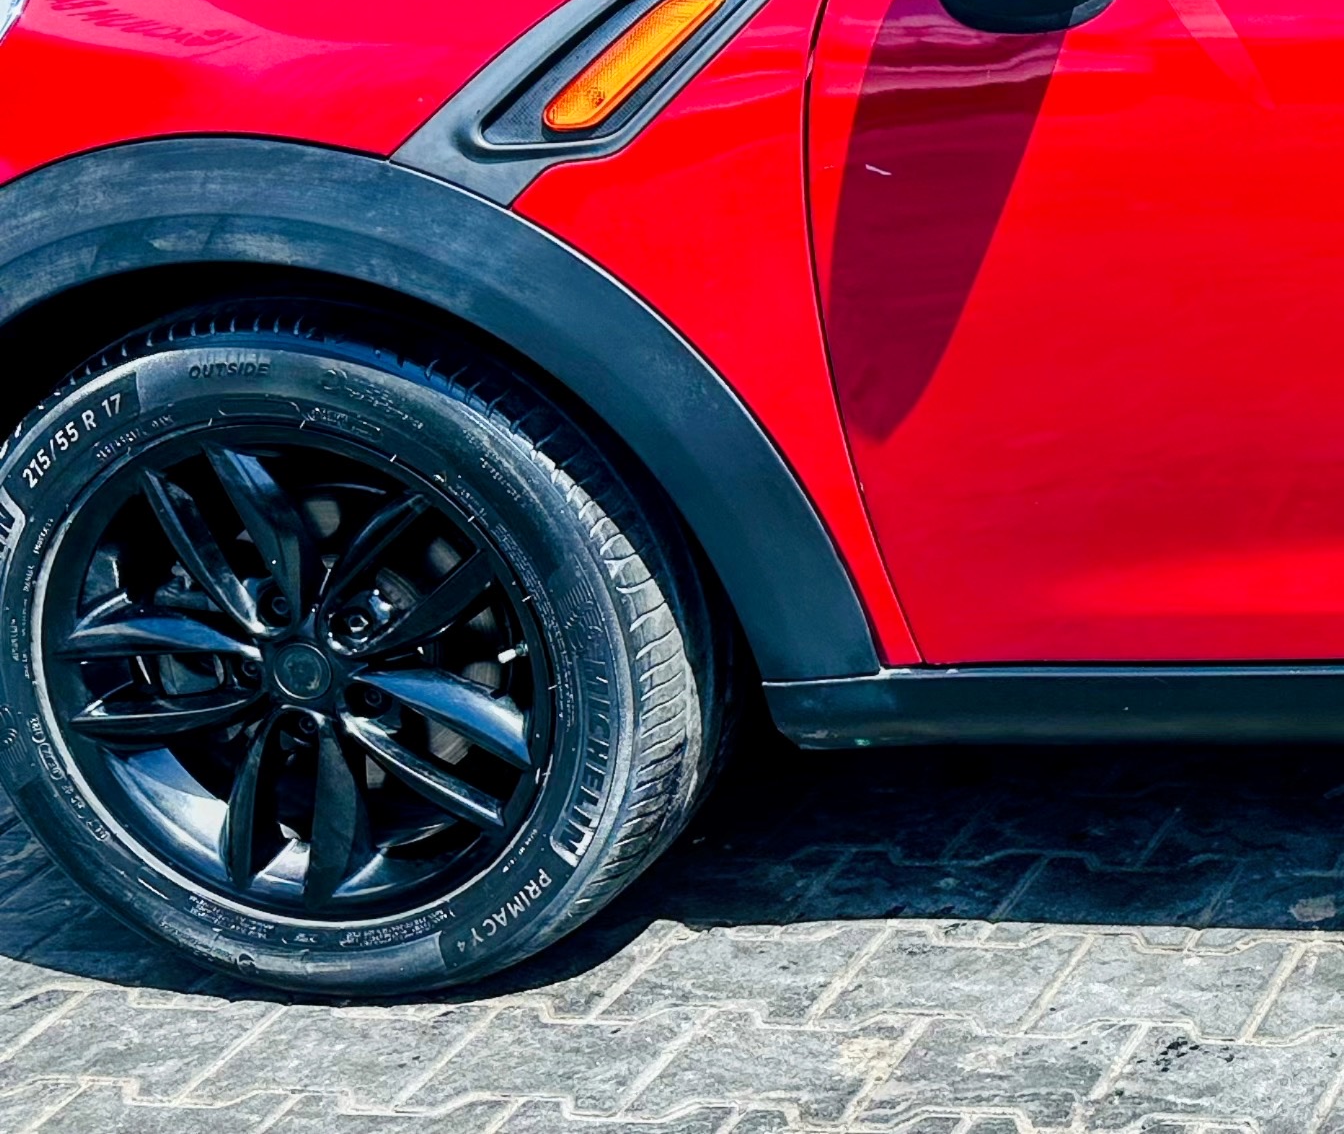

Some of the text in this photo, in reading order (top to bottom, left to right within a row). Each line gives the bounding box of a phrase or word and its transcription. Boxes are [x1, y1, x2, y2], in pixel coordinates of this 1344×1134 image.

[188, 361, 271, 380] OUTSIDE
[81, 408, 98, 431] R
[101, 392, 123, 419] 17
[469, 867, 553, 945] PRIMACY
